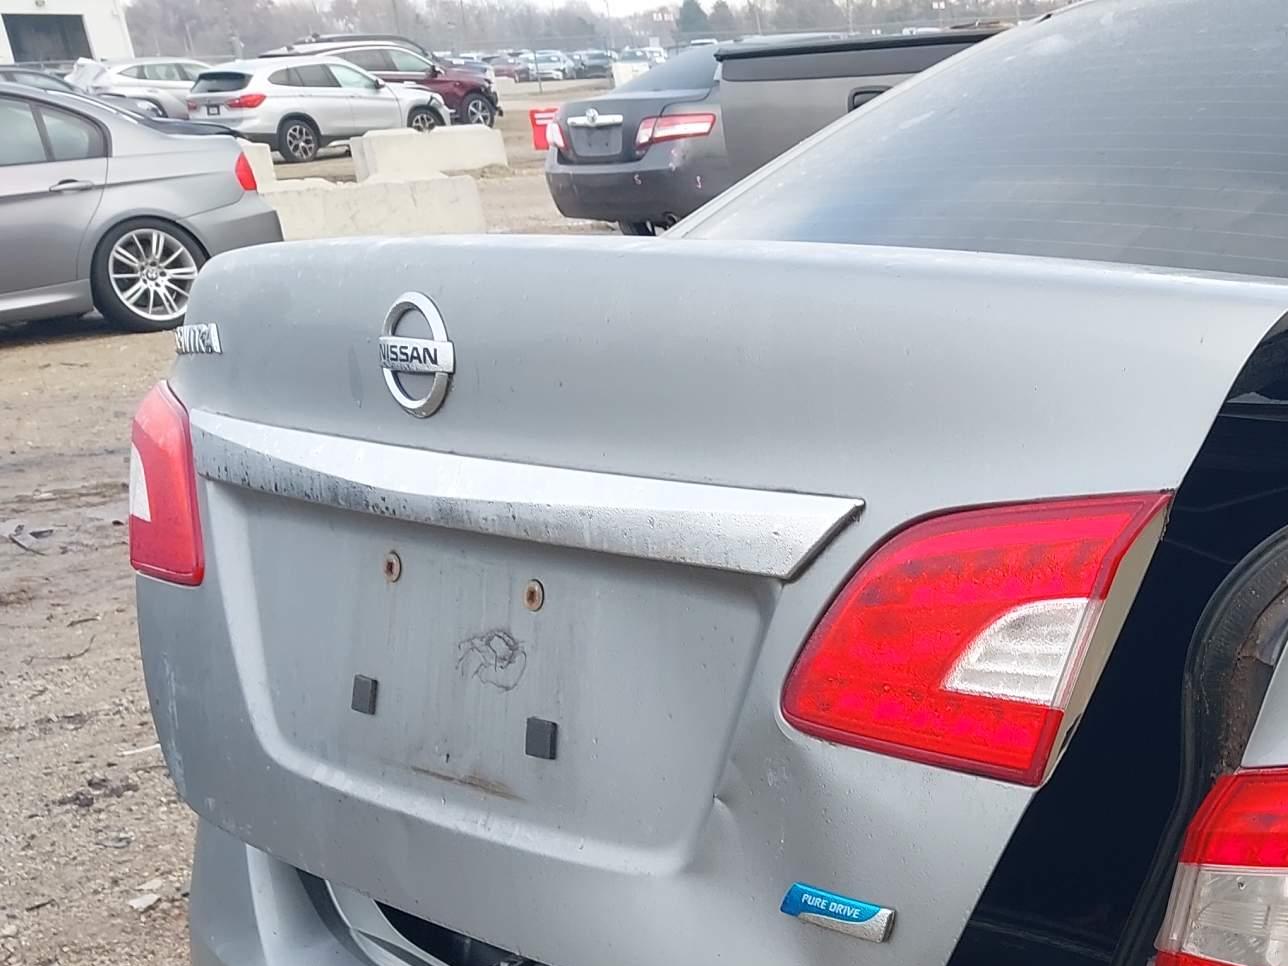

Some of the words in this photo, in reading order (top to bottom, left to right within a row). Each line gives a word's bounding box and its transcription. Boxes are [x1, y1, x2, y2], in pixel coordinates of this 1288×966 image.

[378, 343, 438, 366] NISSAN
[801, 893, 829, 910] PURE
[828, 901, 861, 918] DRIVE
